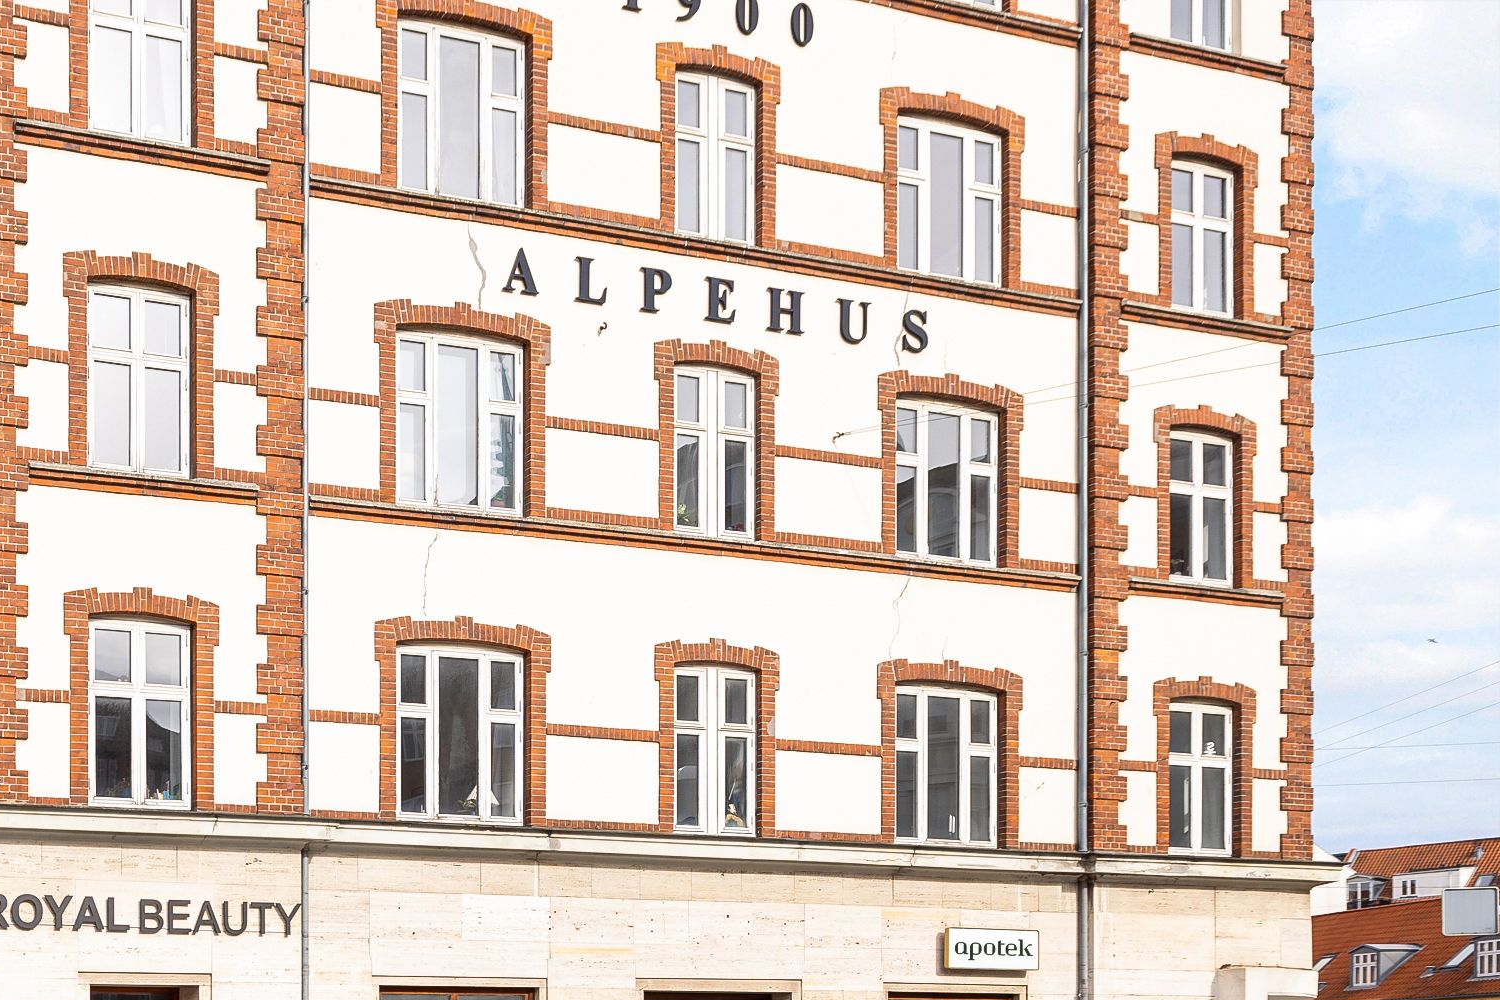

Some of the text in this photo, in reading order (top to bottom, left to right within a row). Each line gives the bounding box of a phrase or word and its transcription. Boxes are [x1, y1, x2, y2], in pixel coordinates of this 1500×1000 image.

[501, 247, 928, 354] ALPEHUS
[138, 899, 301, 938] BEAUTY
[954, 939, 1034, 961] apotek
